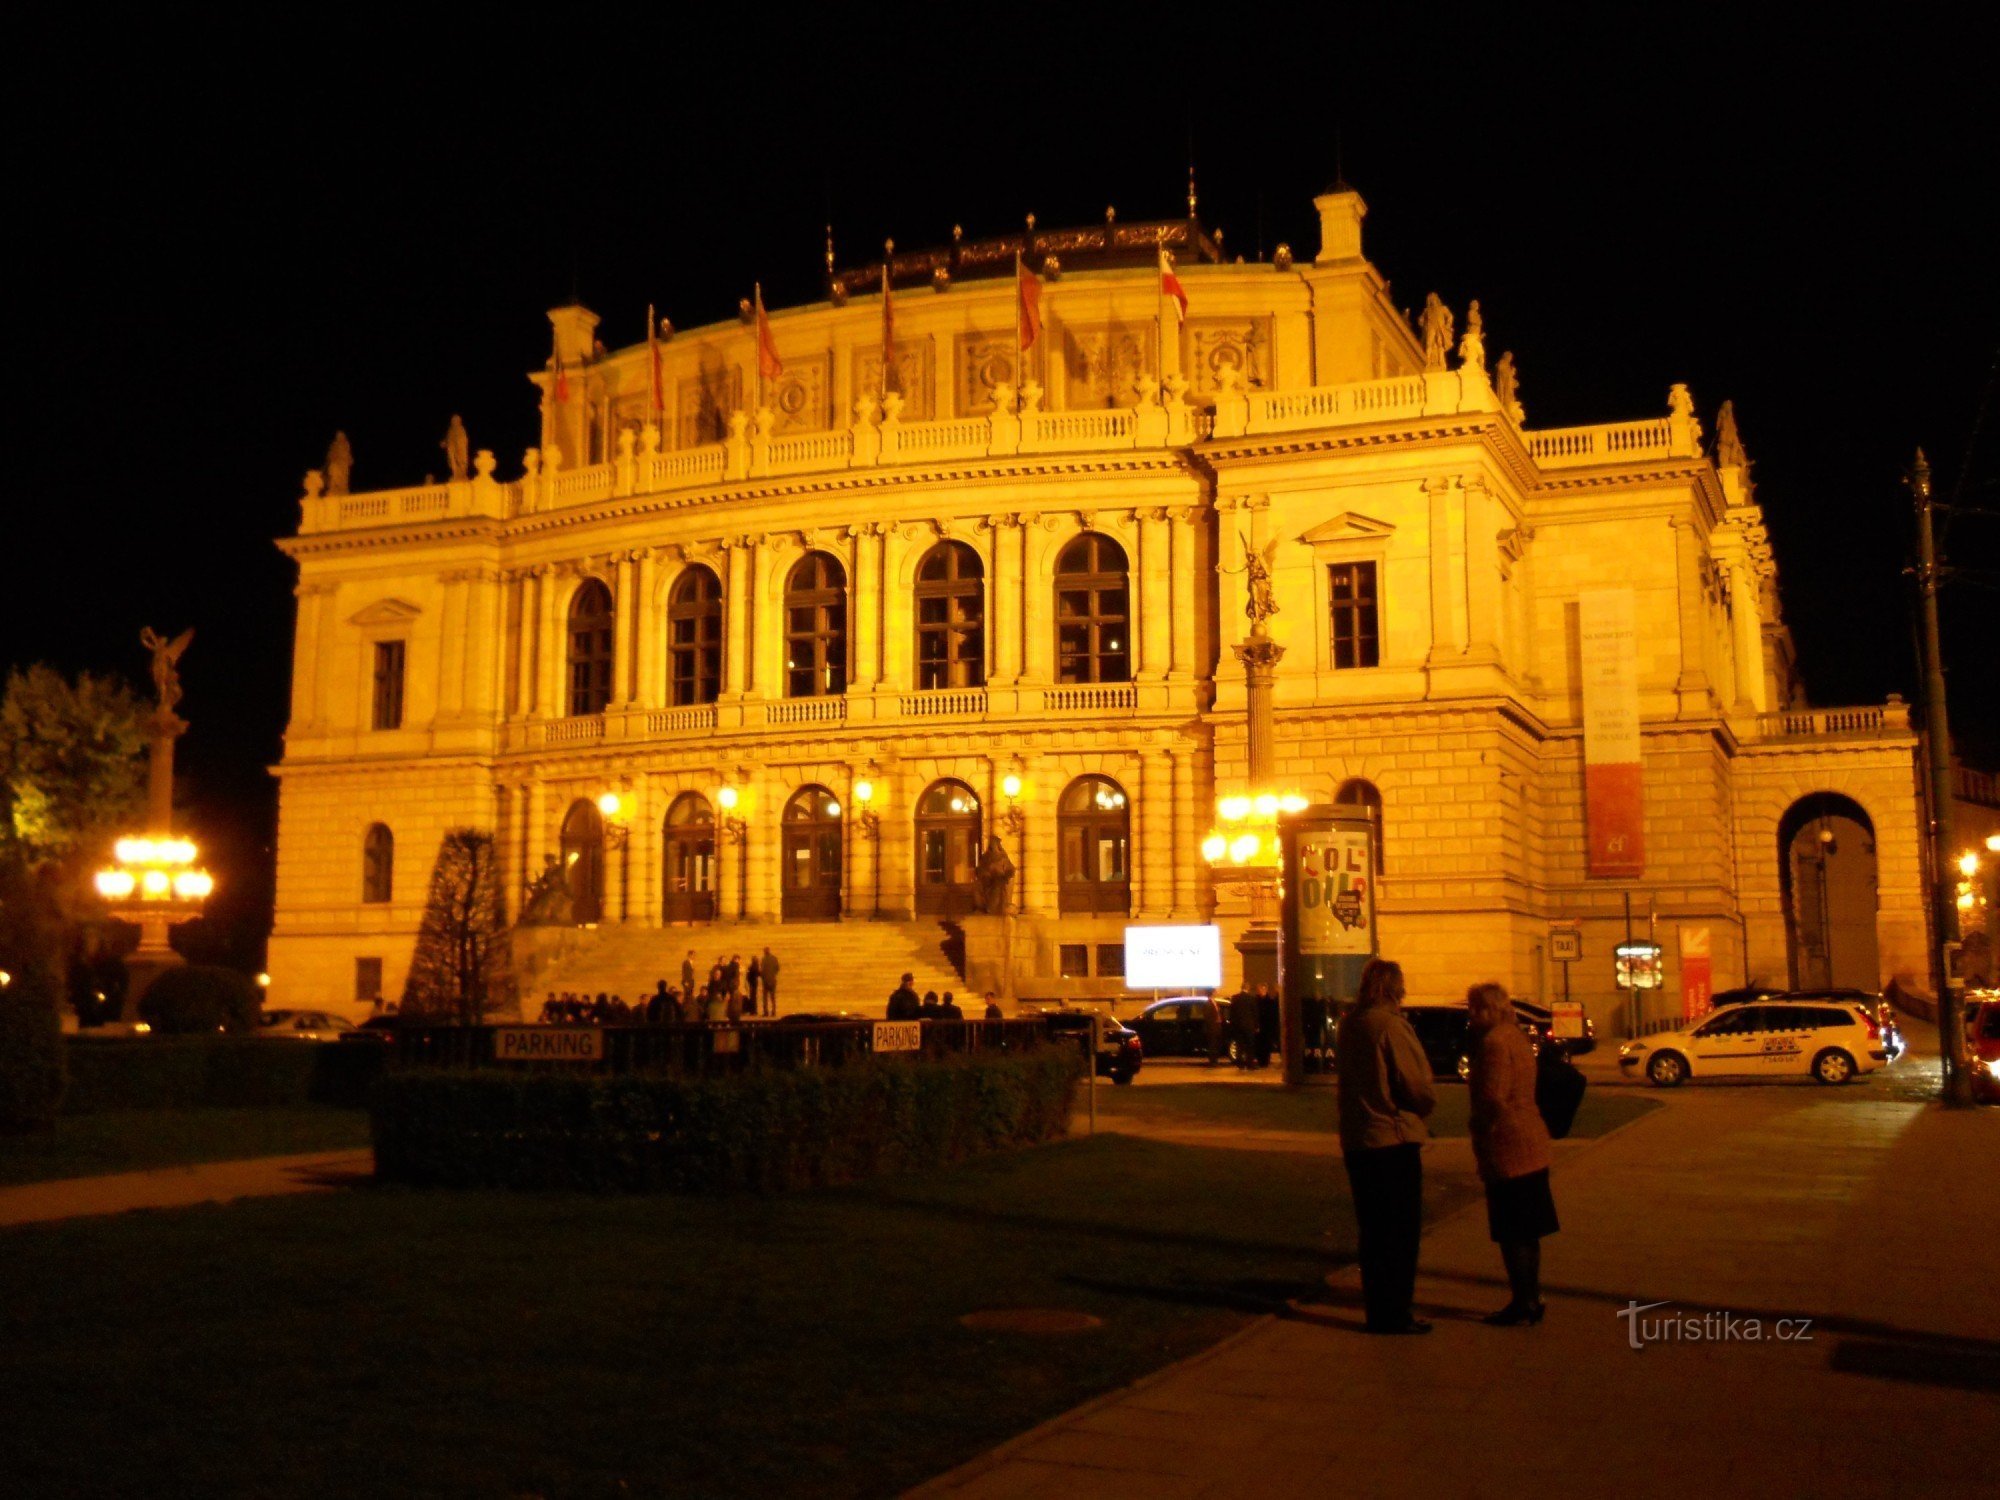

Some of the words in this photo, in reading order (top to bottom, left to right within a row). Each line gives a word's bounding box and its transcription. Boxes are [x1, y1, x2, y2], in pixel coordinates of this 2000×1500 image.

[1555, 940, 1574, 952] TAXI
[504, 1033, 593, 1056] PARKING
[876, 1024, 918, 1048] PARKING
